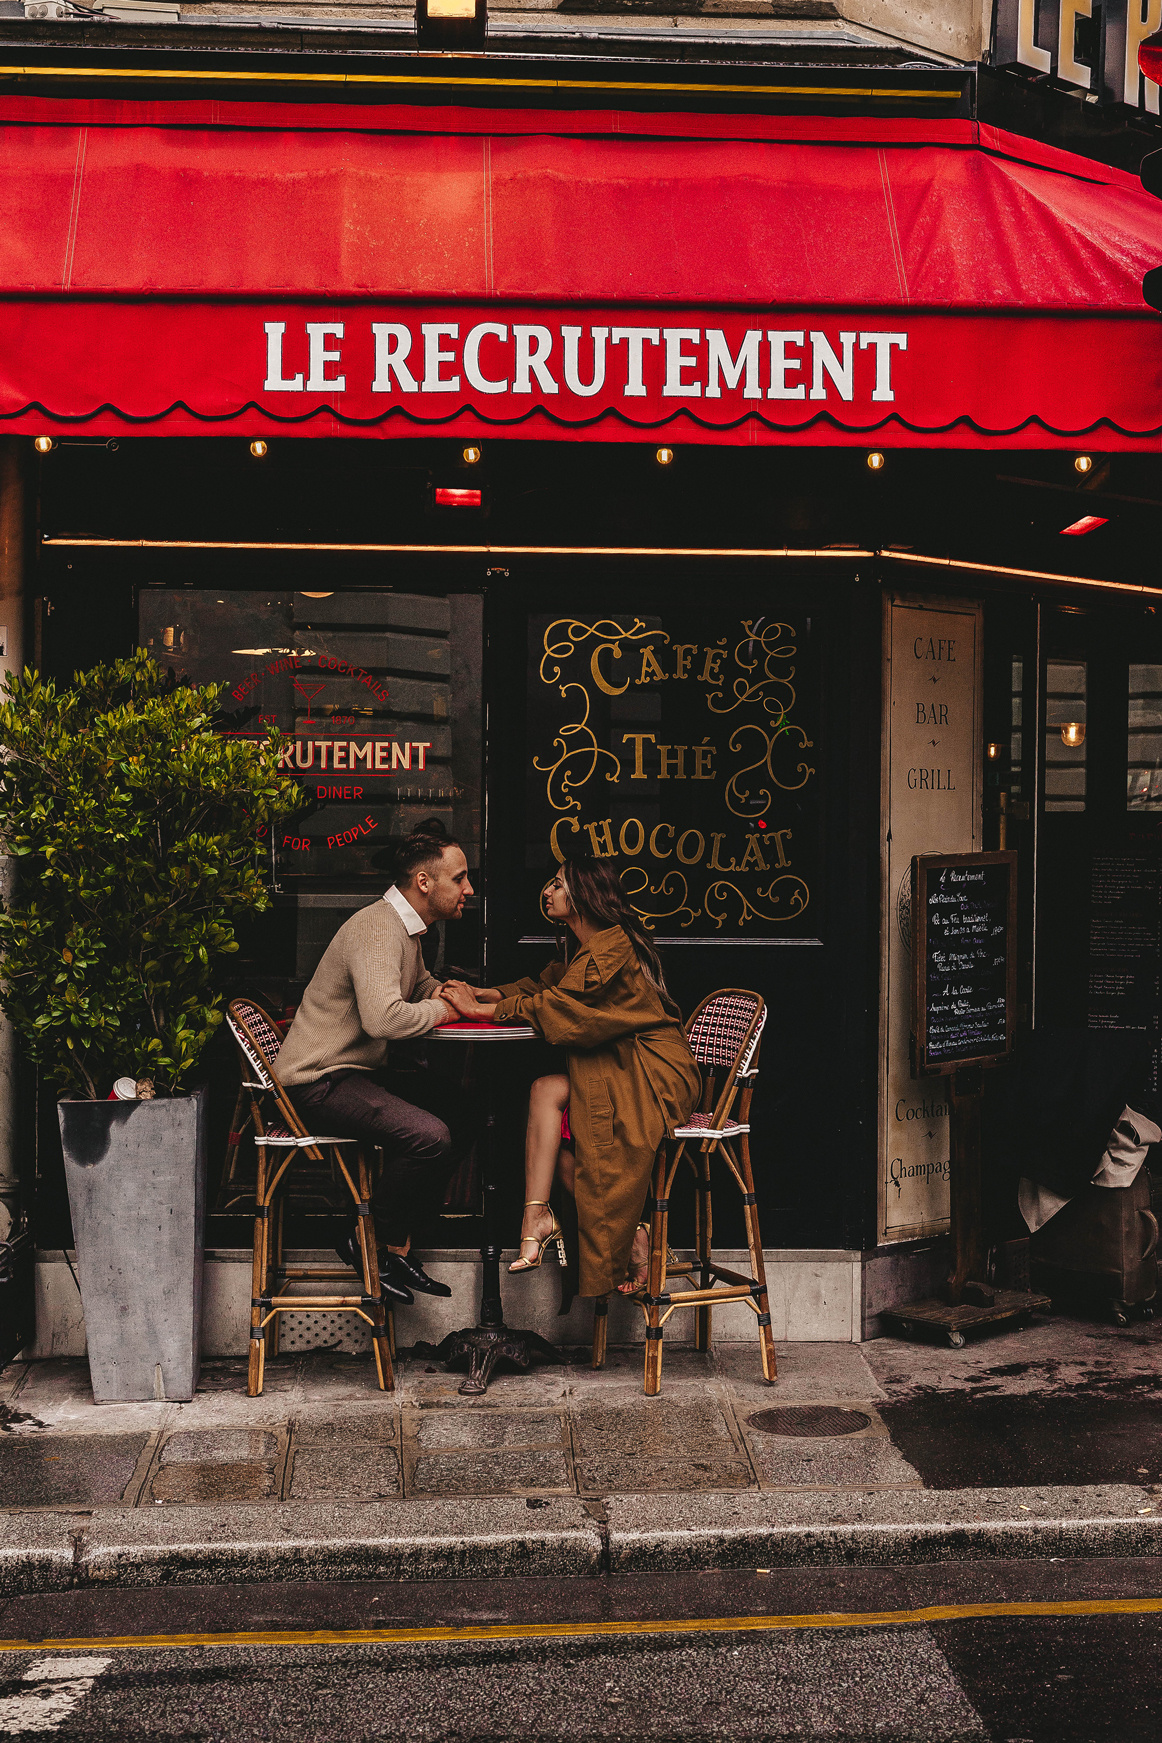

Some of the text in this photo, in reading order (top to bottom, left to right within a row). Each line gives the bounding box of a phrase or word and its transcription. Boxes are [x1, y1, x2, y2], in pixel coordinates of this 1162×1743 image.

[264, 322, 908, 402] LE RECRUTEMENT
[913, 637, 956, 662] CAFE
[231, 655, 390, 702] BEER WINE COCKTAILS
[258, 714, 277, 724] EST
[916, 702, 949, 725] BAR
[622, 733, 717, 779] THÉ
[907, 767, 956, 790] GRILL
[316, 785, 364, 799] DINER
[282, 815, 379, 851] FOR PEOPLE
[549, 816, 793, 872] CHOCOLAT
[895, 1098, 950, 1122] Cocktai
